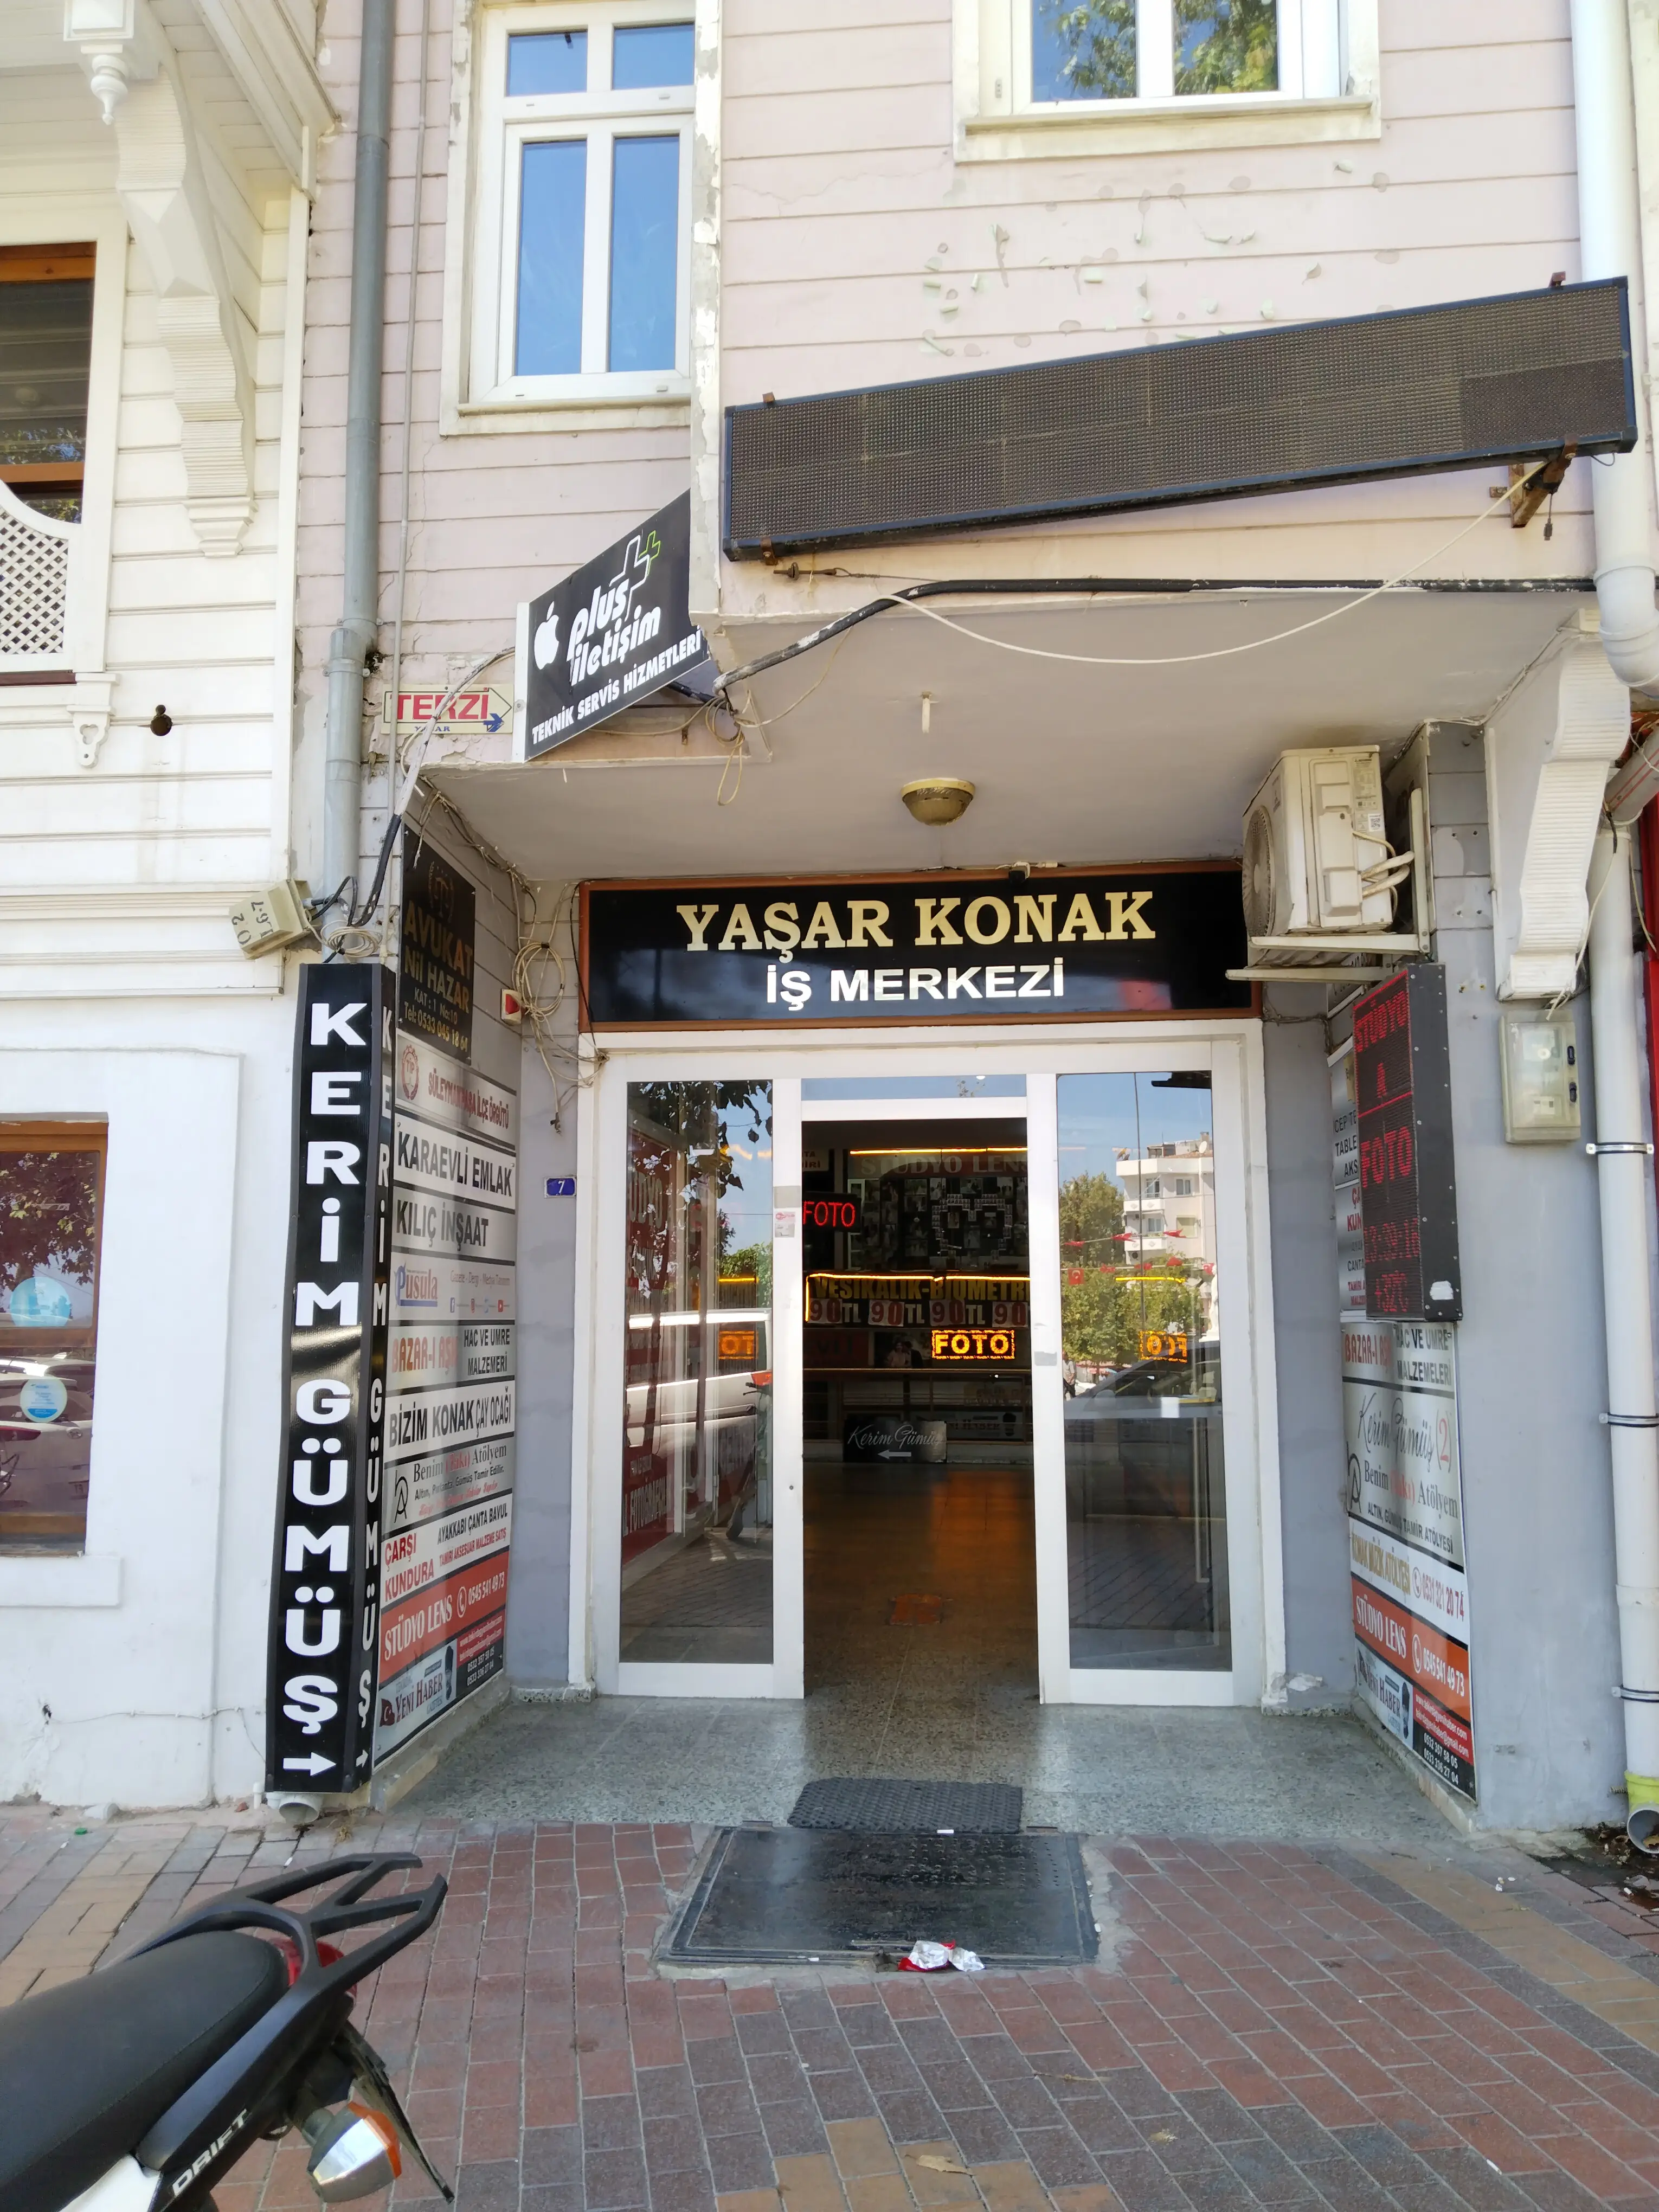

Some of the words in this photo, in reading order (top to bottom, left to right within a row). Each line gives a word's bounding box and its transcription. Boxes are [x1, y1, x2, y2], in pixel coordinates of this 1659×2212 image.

[571, 605, 661, 686] iletişim
[532, 707, 574, 744] TEKNİK
[577, 678, 620, 718] SERVİS
[623, 625, 700, 693] HİZMETLERİ
[404, 899, 472, 980] AVUKAT
[676, 899, 893, 962] YAŞAR
[915, 891, 1156, 946] KONAK
[405, 946, 423, 983] Nil
[427, 961, 469, 1013] HAZAR
[414, 987, 427, 1006] KAT
[766, 964, 812, 1010] İŞ
[829, 957, 1064, 1001] MERKEZİ
[417, 1009, 435, 1034] 0533
[437, 1020, 449, 1041] 045
[452, 1029, 459, 1047] 18
[1335, 1115, 1347, 1133] CEP
[398, 1131, 467, 1185] KARAEVLİ
[472, 1157, 512, 1197] EMLAK
[973, 1154, 1027, 1173] LEN
[558, 1180, 565, 1193] 7
[396, 1199, 437, 1247] KILIÇ
[441, 1201, 488, 1251] İNŞAAT
[802, 1201, 856, 1227] FOTO
[392, 1337, 435, 1373] BAZAR-I
[464, 1329, 478, 1347] HAC
[480, 1329, 488, 1346] VE
[490, 1328, 510, 1346] UMRE
[934, 1334, 1009, 1355] FOTO
[1345, 1333, 1378, 1365] BAZAR-I
[1411, 1328, 1423, 1348] VE
[1425, 1329, 1449, 1350] UMRE
[1397, 1360, 1452, 1386] MALZEMELERİ
[389, 1401, 428, 1448] BİZİM
[432, 1400, 474, 1438] KONAK
[476, 1398, 488, 1437] ÇAY
[490, 1386, 511, 1426] OCAĞI
[847, 1424, 893, 1450] Kerim
[413, 1459, 443, 1482] Benim
[472, 1444, 506, 1465] Atölyem
[1364, 1459, 1389, 1490] Benim
[1418, 1480, 1458, 1520] Atölyem
[437, 1517, 466, 1545] AYAKKABI
[468, 1510, 487, 1535] ÇANTA
[489, 1503, 507, 1523] BAVUL
[1404, 1517, 1423, 1539] TAMİR
[1425, 1527, 1454, 1554] ATÖLYESİ
[384, 1533, 417, 1572] ÇARŞI
[384, 1558, 434, 1602] KUNDURA
[1446, 1586, 1454, 1617] 20
[384, 1610, 425, 1661] STÜDYO
[427, 1594, 453, 1634] LENS
[1355, 1594, 1384, 1642] STÜDYO
[1385, 1616, 1407, 1659] LENS
[1423, 1647, 1436, 1677] 0545
[1436, 1656, 1446, 1685] 541
[1447, 1666, 1455, 1692] 49
[1456, 1672, 1465, 1697] 73
[416, 1673, 442, 1708] HABER
[1379, 1676, 1400, 1718] HABER
[1444, 1766, 1450, 1778] 27
[1451, 1771, 1459, 1785] 04
[1451, 1754, 1458, 1769] 05
[172, 2108, 250, 2197] DRIFT
